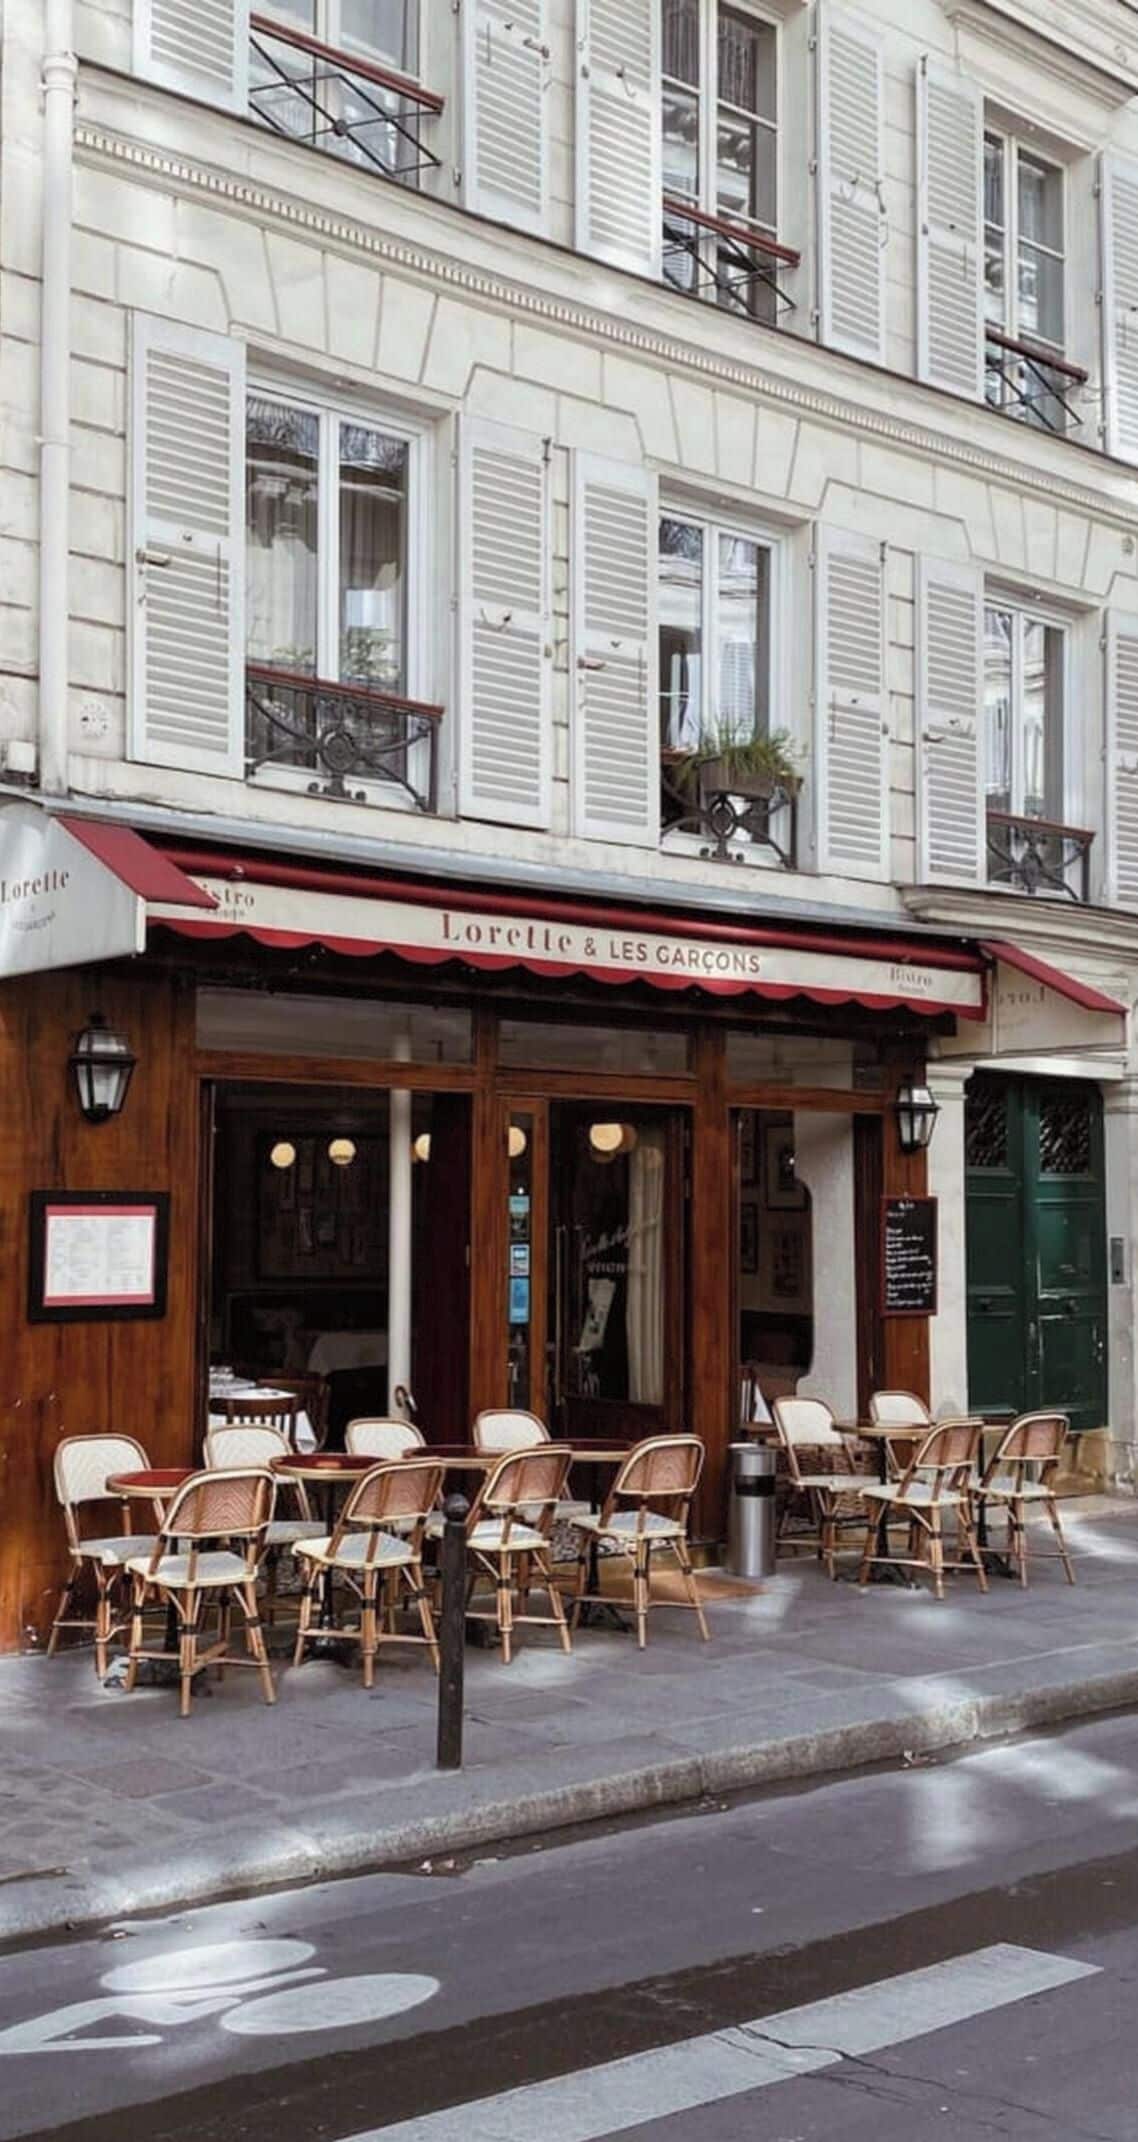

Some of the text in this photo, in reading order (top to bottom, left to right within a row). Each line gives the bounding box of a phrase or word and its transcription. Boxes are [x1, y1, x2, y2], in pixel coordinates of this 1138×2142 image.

[0, 869, 69, 904] Lorette
[442, 912, 761, 974] Lorette & LES GARÇONS
